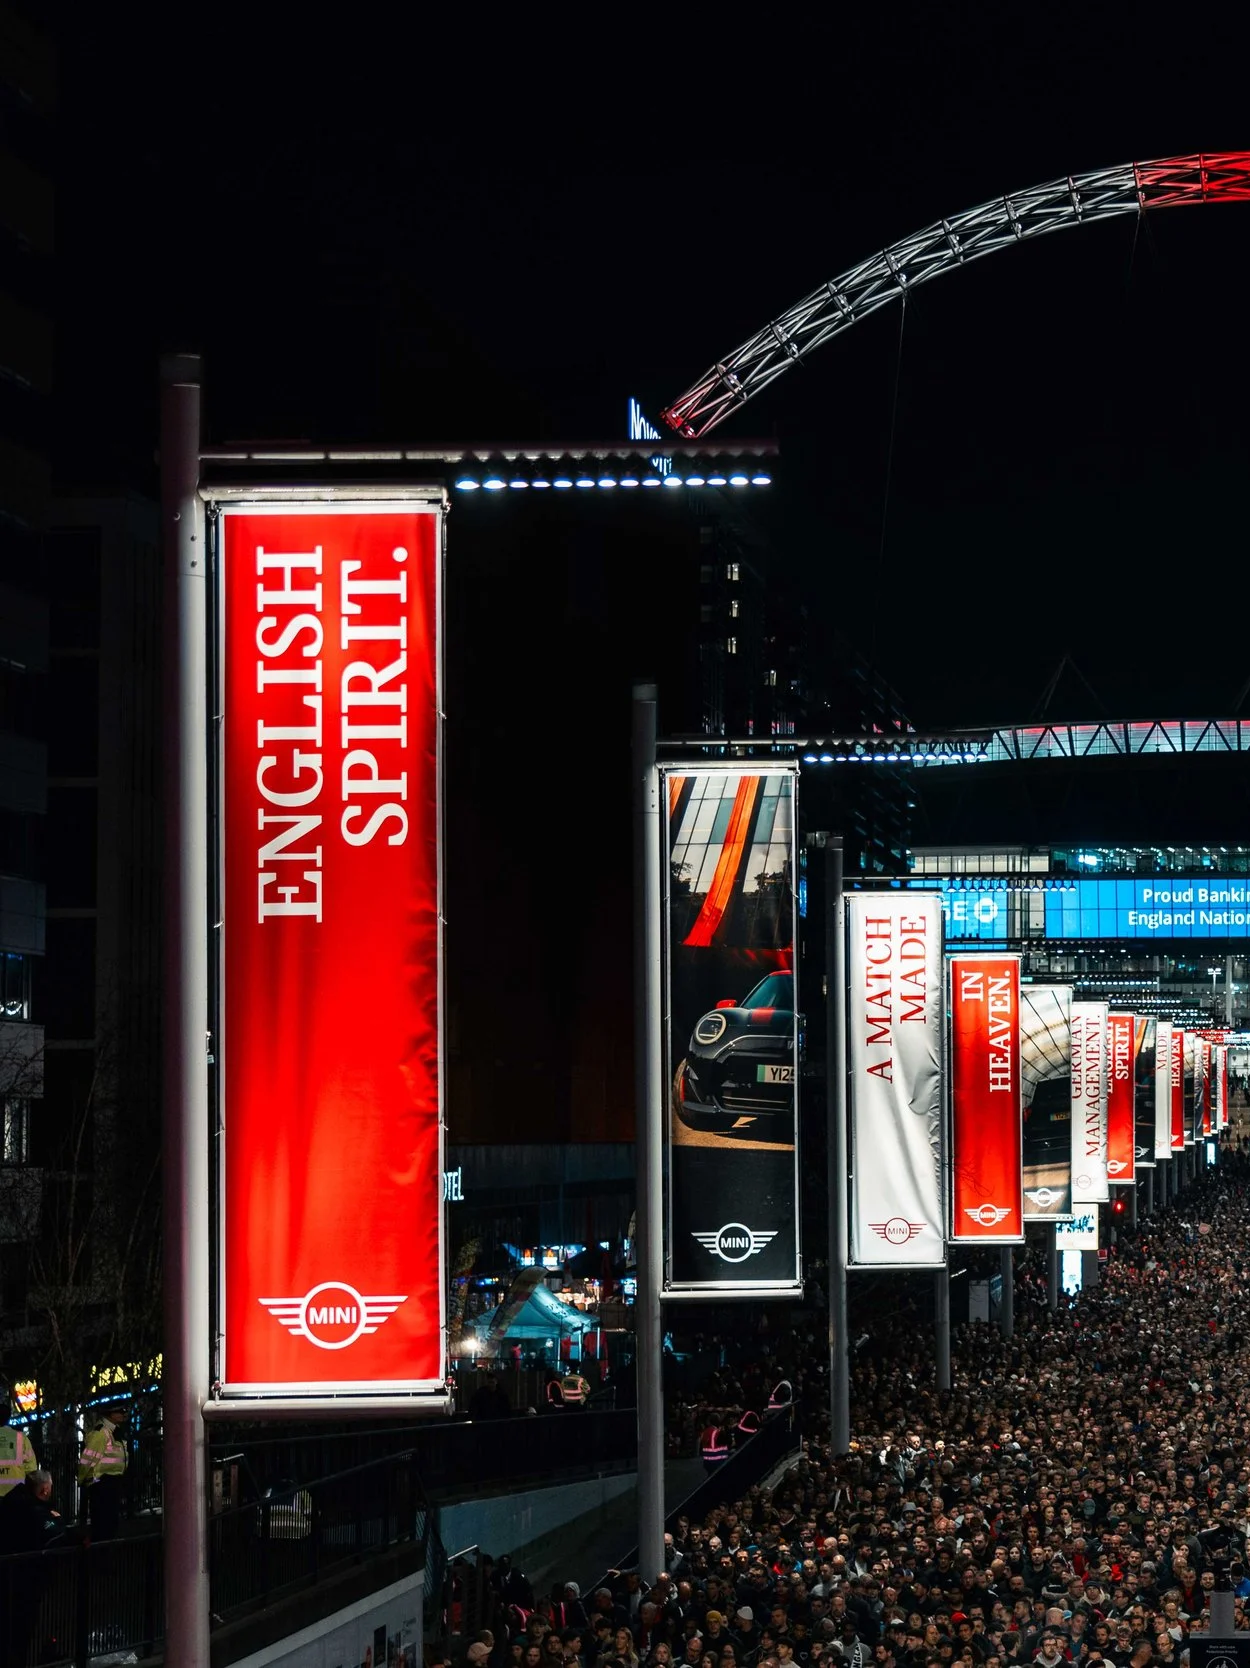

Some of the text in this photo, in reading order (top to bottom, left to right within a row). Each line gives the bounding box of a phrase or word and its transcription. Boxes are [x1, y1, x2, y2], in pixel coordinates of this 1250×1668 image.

[341, 546, 408, 846] SPIRIT.
[256, 545, 323, 923] ENGLISH
[1128, 910, 1195, 929] England
[1143, 888, 1194, 903] Proud
[900, 916, 926, 1024] MADE
[962, 970, 984, 1002] IN
[866, 916, 893, 1083] A MATCH
[988, 970, 1011, 1092] HEAVEN.
[1115, 1021, 1130, 1079] SPIRIT.
[1085, 1015, 1100, 1156] MANAGEMENT.
[721, 1236, 749, 1248] MINI
[888, 1227, 908, 1235] MINI
[309, 1307, 357, 1325] MINI
